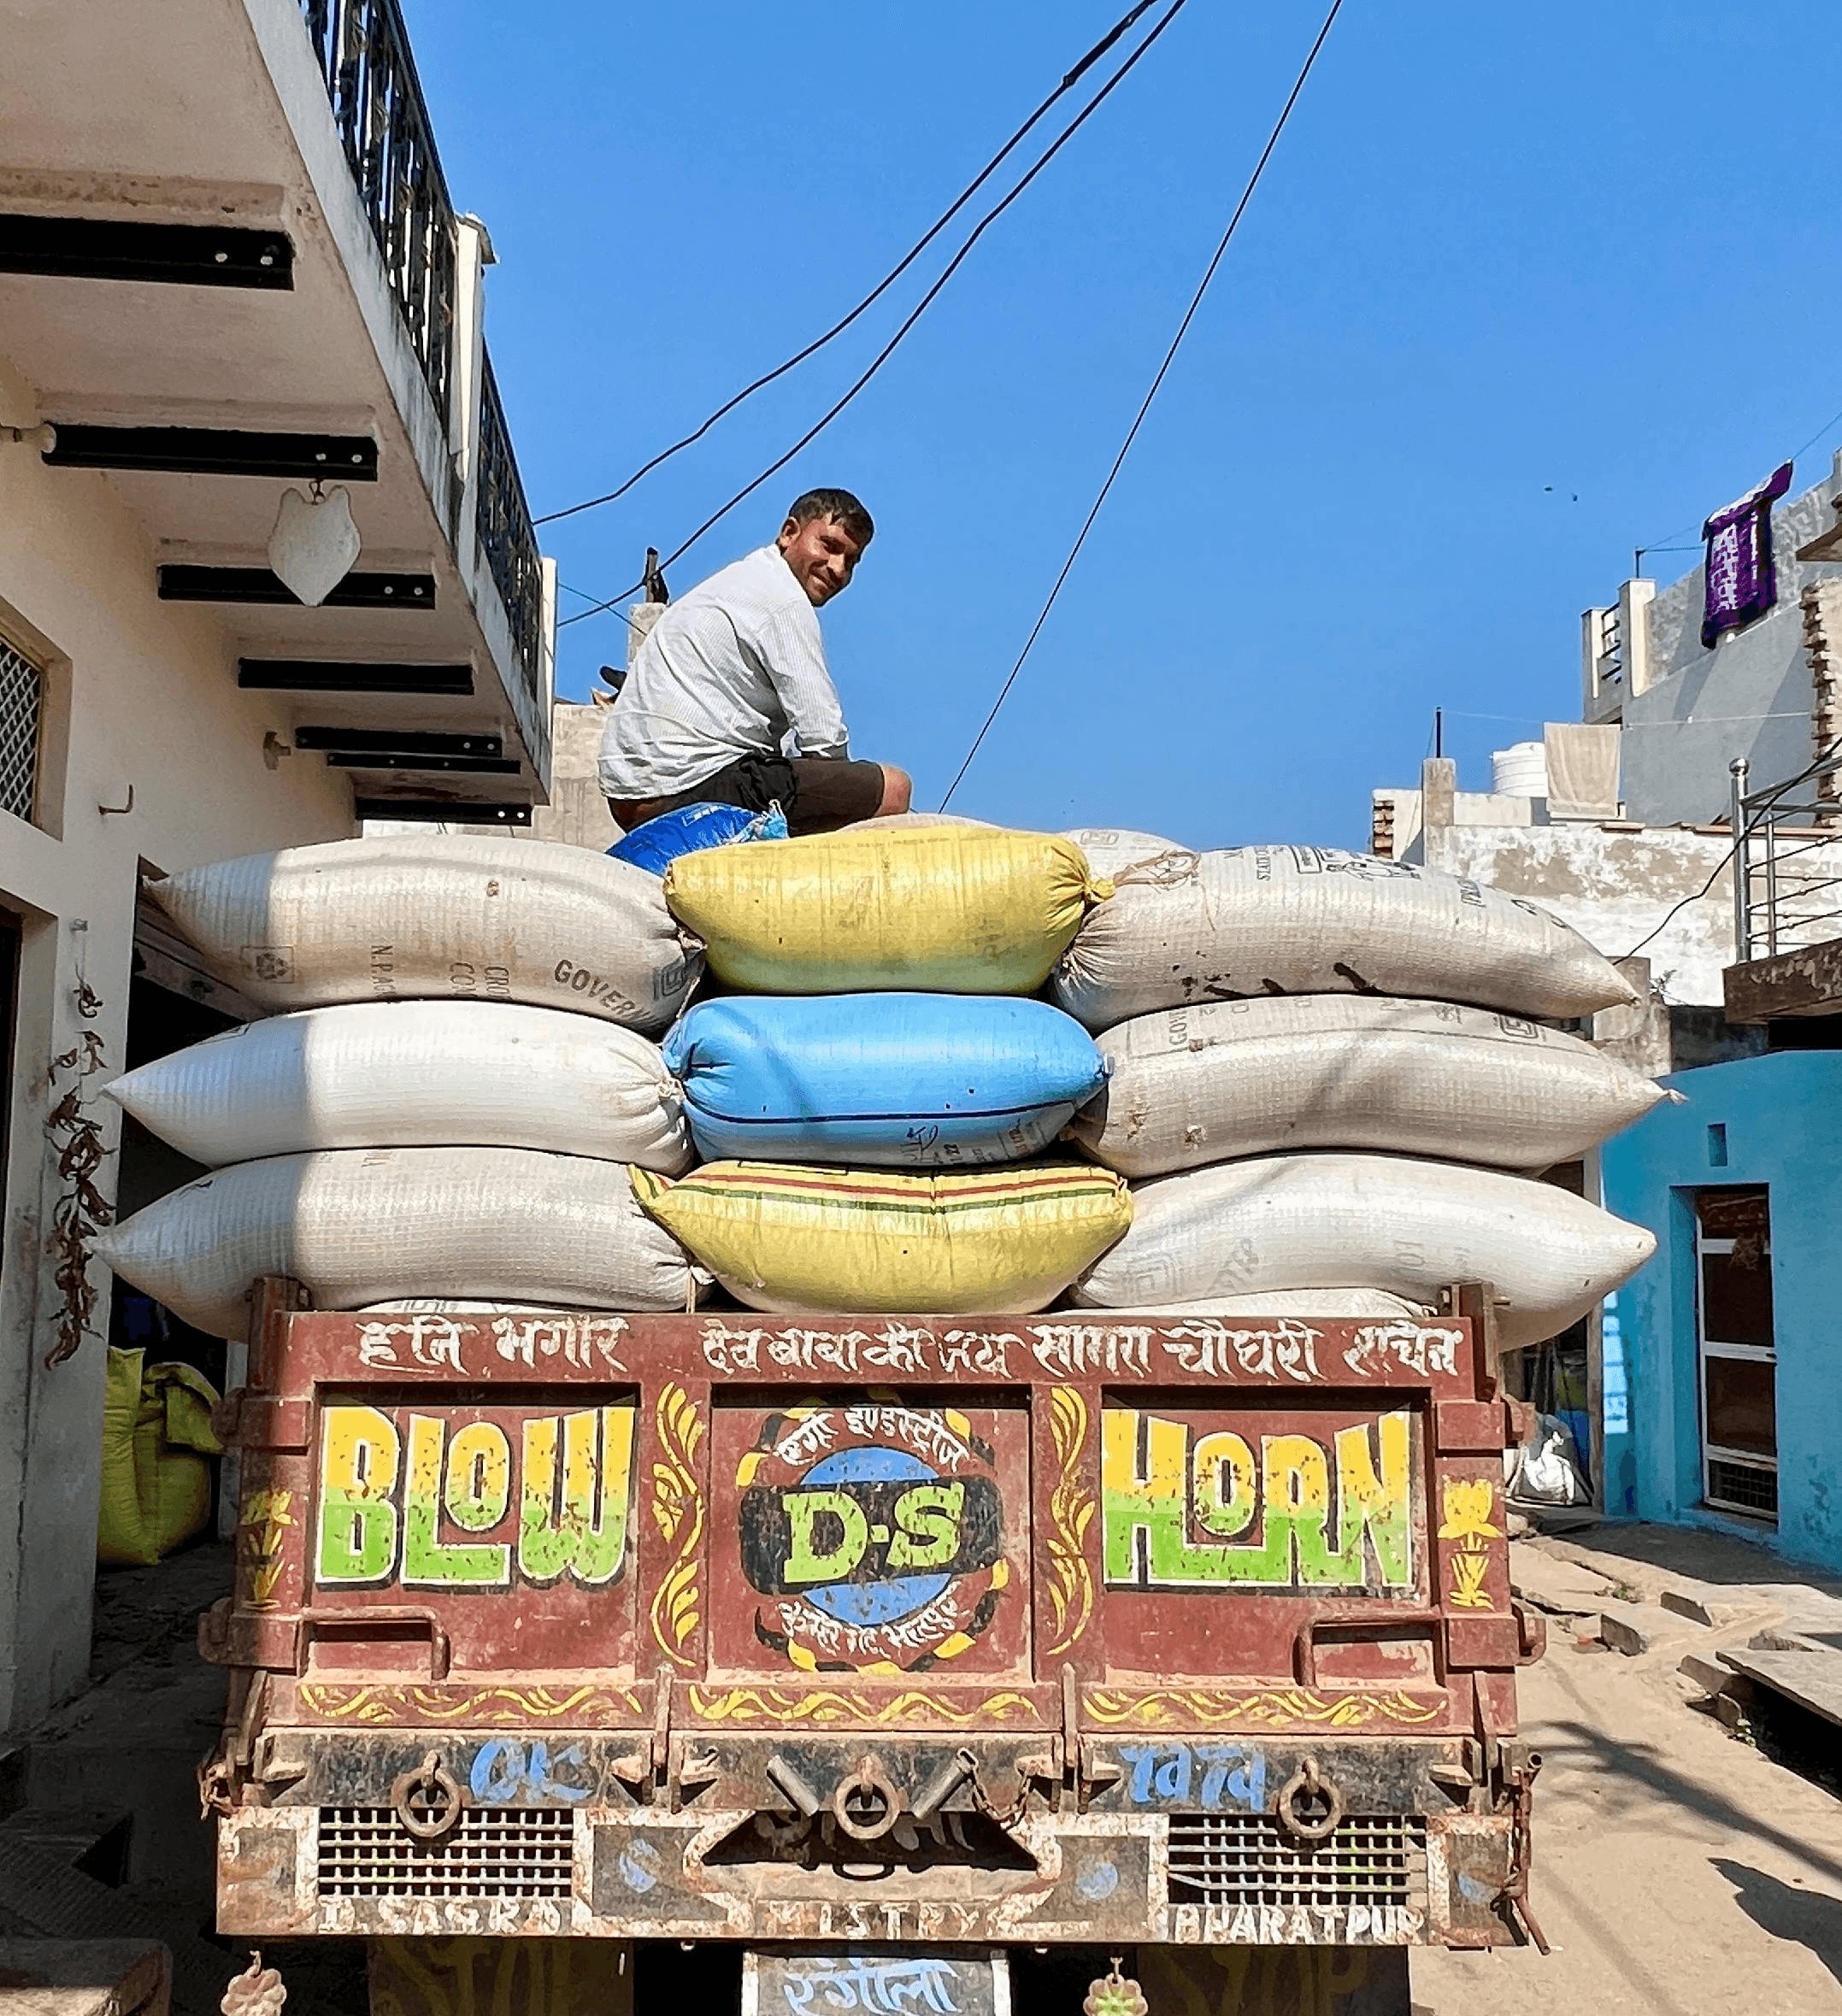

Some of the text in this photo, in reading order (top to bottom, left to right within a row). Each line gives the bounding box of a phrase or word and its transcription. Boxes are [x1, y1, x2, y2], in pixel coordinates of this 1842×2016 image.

[315, 1404, 636, 1587] BLOW
[1102, 1404, 1413, 1588] HORN
[1174, 1904, 1425, 1945] BHARATPUR
